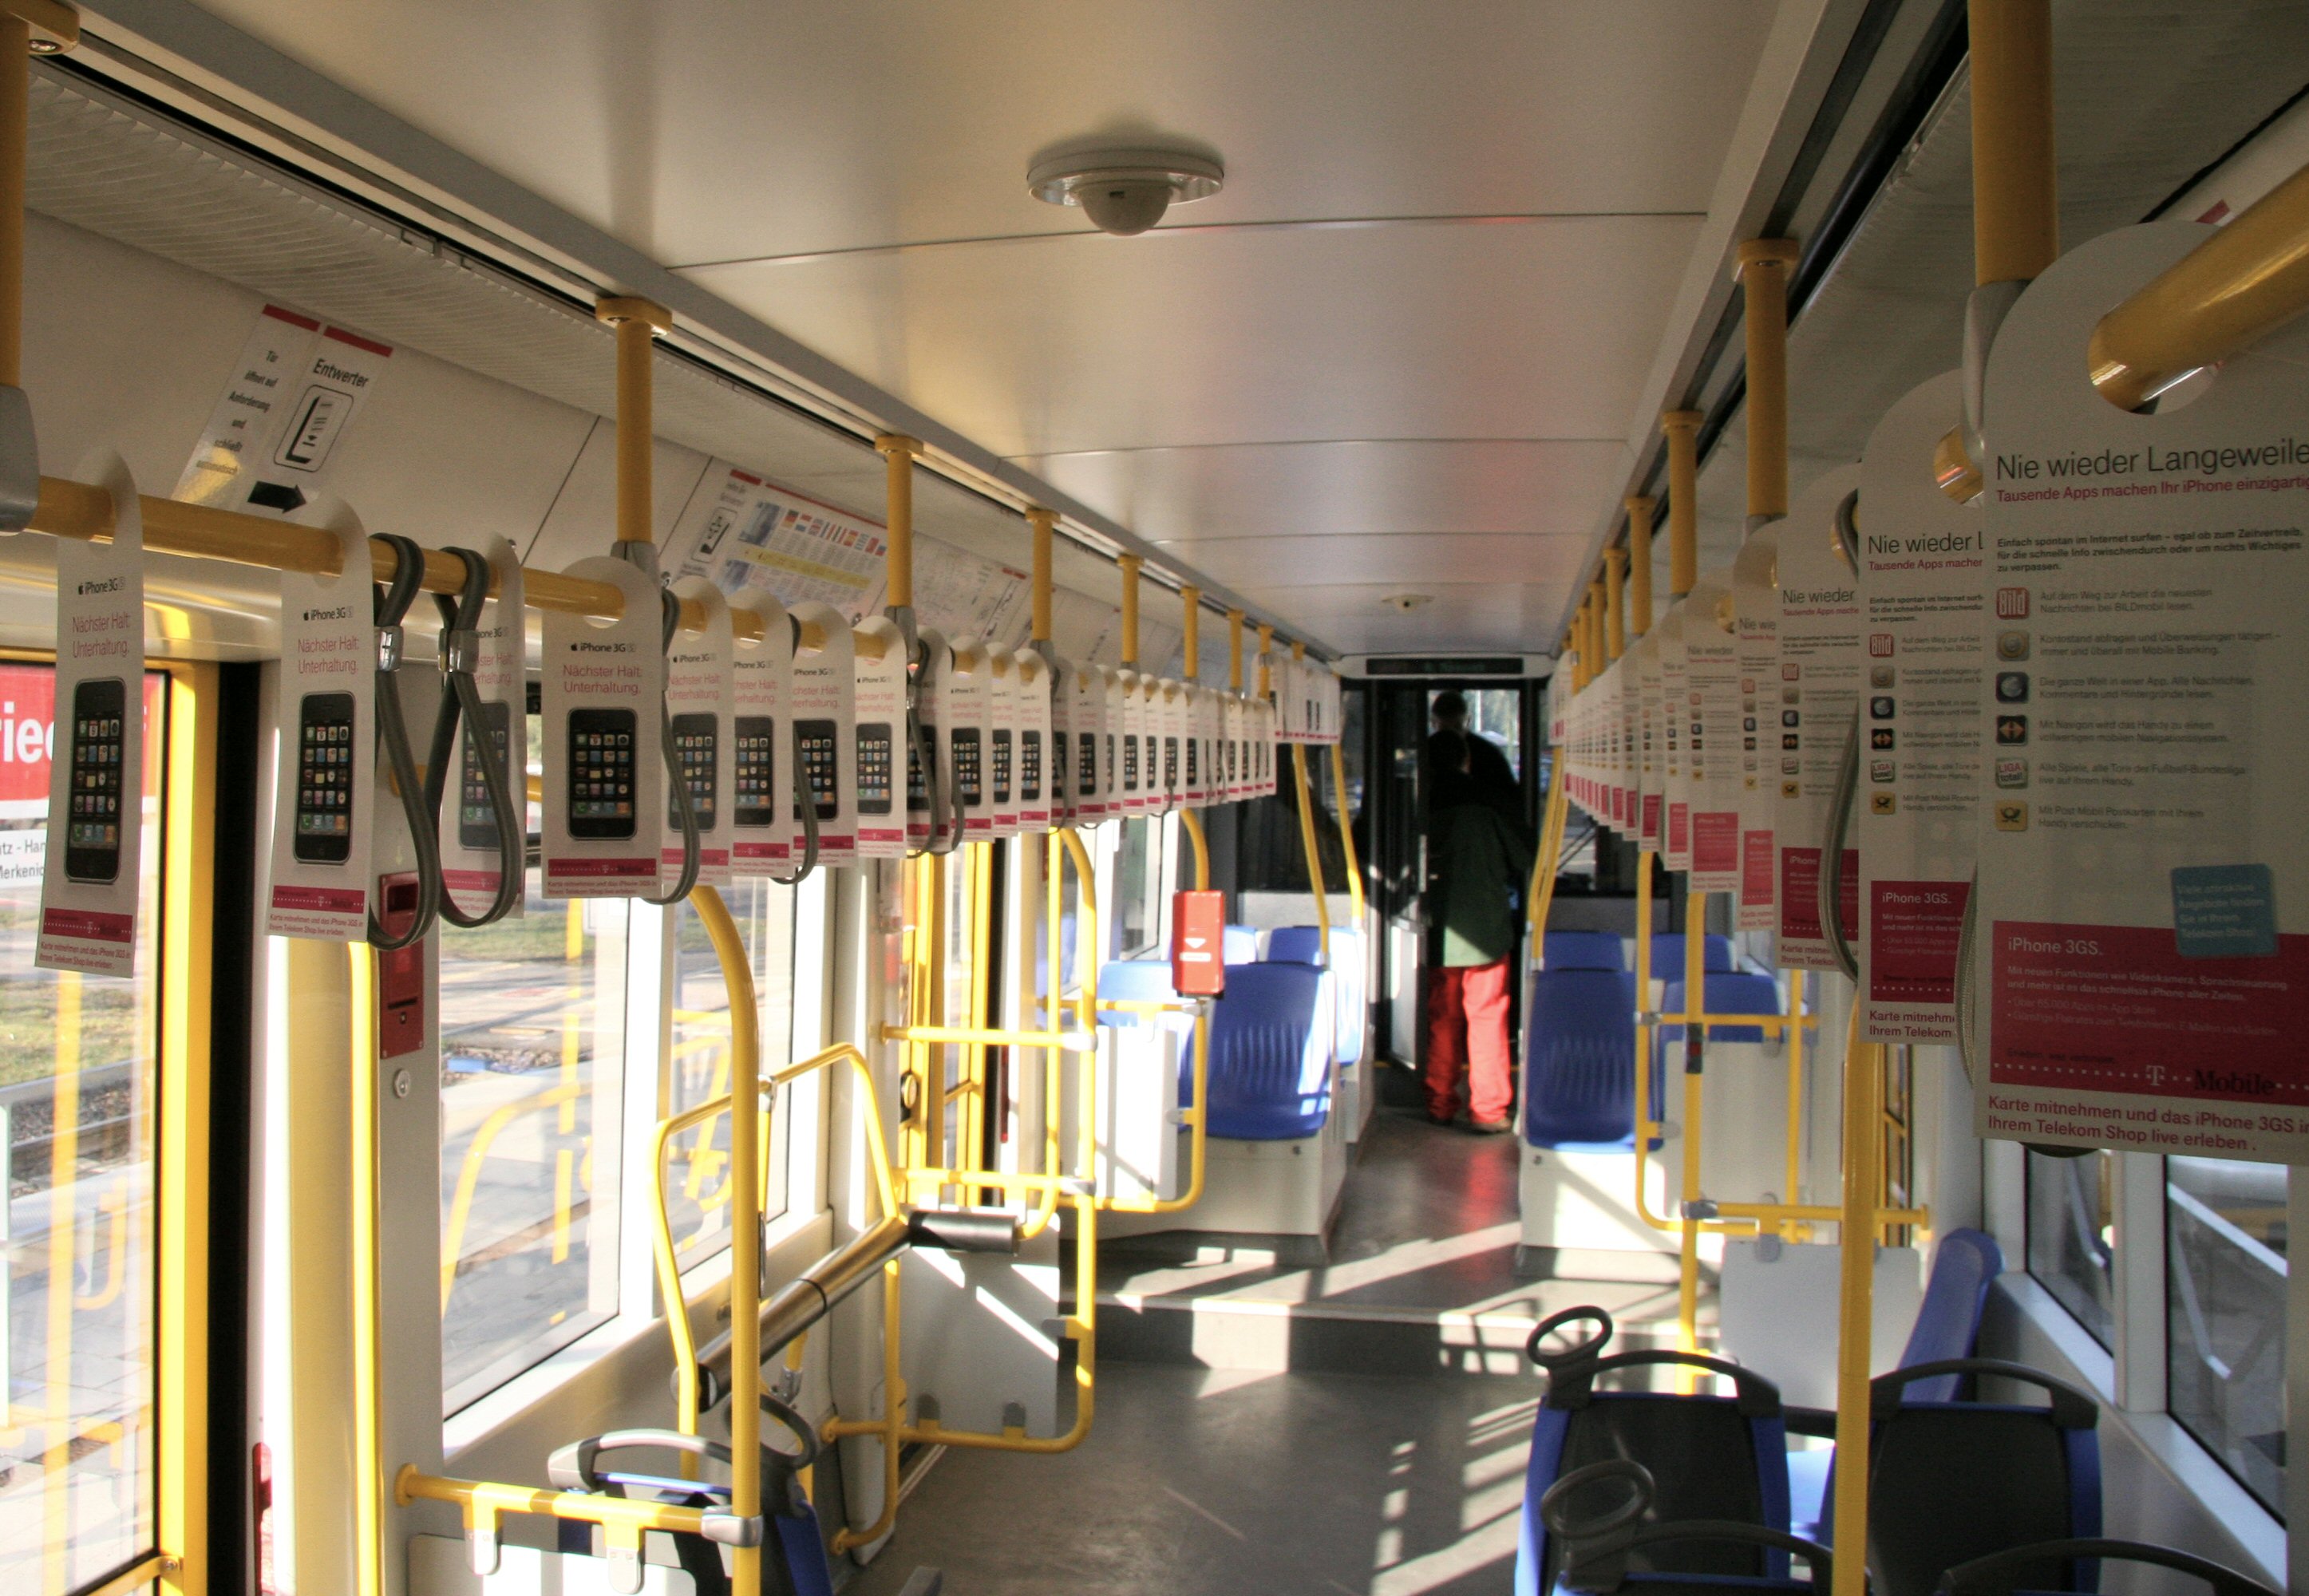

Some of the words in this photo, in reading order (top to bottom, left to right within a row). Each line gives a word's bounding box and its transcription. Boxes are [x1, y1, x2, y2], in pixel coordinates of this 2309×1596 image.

[313, 358, 369, 387] Entwerter
[1997, 455, 2039, 480] Nie
[2046, 449, 2139, 477] wieder
[2148, 438, 2309, 475] Langeweile
[1997, 489, 2060, 502] Tausende
[2062, 487, 2098, 500] Apps
[2101, 483, 2156, 496] machen
[2161, 482, 2177, 495] Ihr
[2183, 480, 2233, 493] iPhone
[1868, 535, 1900, 555] Nie
[1905, 532, 1971, 552] wieder
[1997, 538, 2033, 547] Einfach
[2034, 537, 2073, 547] spontan
[2090, 535, 2129, 544] Internet
[2130, 533, 2162, 543] surfen
[2173, 532, 2196, 543] egal
[2198, 531, 2212, 540] ob
[1997, 551, 2010, 559] für
[2012, 550, 2027, 559] die
[2029, 549, 2069, 558] schnelle
[2071, 548, 2090, 557] Info
[2092, 546, 2167, 556] zwischendurch
[2169, 545, 2193, 554] oder
[2214, 543, 2246, 552] nichts
[2248, 541, 2302, 553] Wichtiges
[1868, 560, 1915, 571] Tausende
[1917, 559, 1943, 570] Apps
[2010, 564, 2062, 573] verpassen.
[85, 582, 107, 595] iPhone
[1783, 590, 1805, 603] Nie
[1809, 587, 1854, 602] wieder
[1999, 591, 2026, 615] Bild
[73, 614, 110, 633] Nächster
[112, 612, 130, 629] Halt:
[311, 610, 335, 620] iPhone
[298, 637, 337, 653] Nächster
[339, 635, 359, 650] Halt:
[580, 643, 611, 652] iPhone
[299, 658, 358, 674] Unterhaltung.
[563, 664, 613, 678] Nächster
[618, 665, 642, 677] Halt:
[564, 681, 641, 696] Unterhaltung.
[1999, 763, 2021, 772] LIGA
[1882, 892, 1921, 903] iPhone
[2008, 937, 2061, 954] iPhone
[2066, 939, 2104, 955] 3GS.
[1869, 1010, 1900, 1021] Karte
[1869, 1025, 1901, 1037] Ihrem
[1904, 1026, 1951, 1038] Telekom
[2145, 1065, 2165, 1086] T
[2193, 1070, 2275, 1095] Mobile
[1988, 1095, 2030, 1113] Karte
[2034, 1100, 2121, 1120] mitnehmen
[2126, 1109, 2157, 1123] und
[2161, 1110, 2191, 1125] das
[2195, 1111, 2253, 1130] iPhone
[2259, 1116, 2294, 1133] 3GS
[1988, 1115, 2031, 1132] Ihrem
[2037, 1120, 2101, 1139] Telekom
[2106, 1125, 2147, 1144] Shop
[2152, 1128, 2179, 1144] live
[2184, 1133, 2248, 1151] erleben
